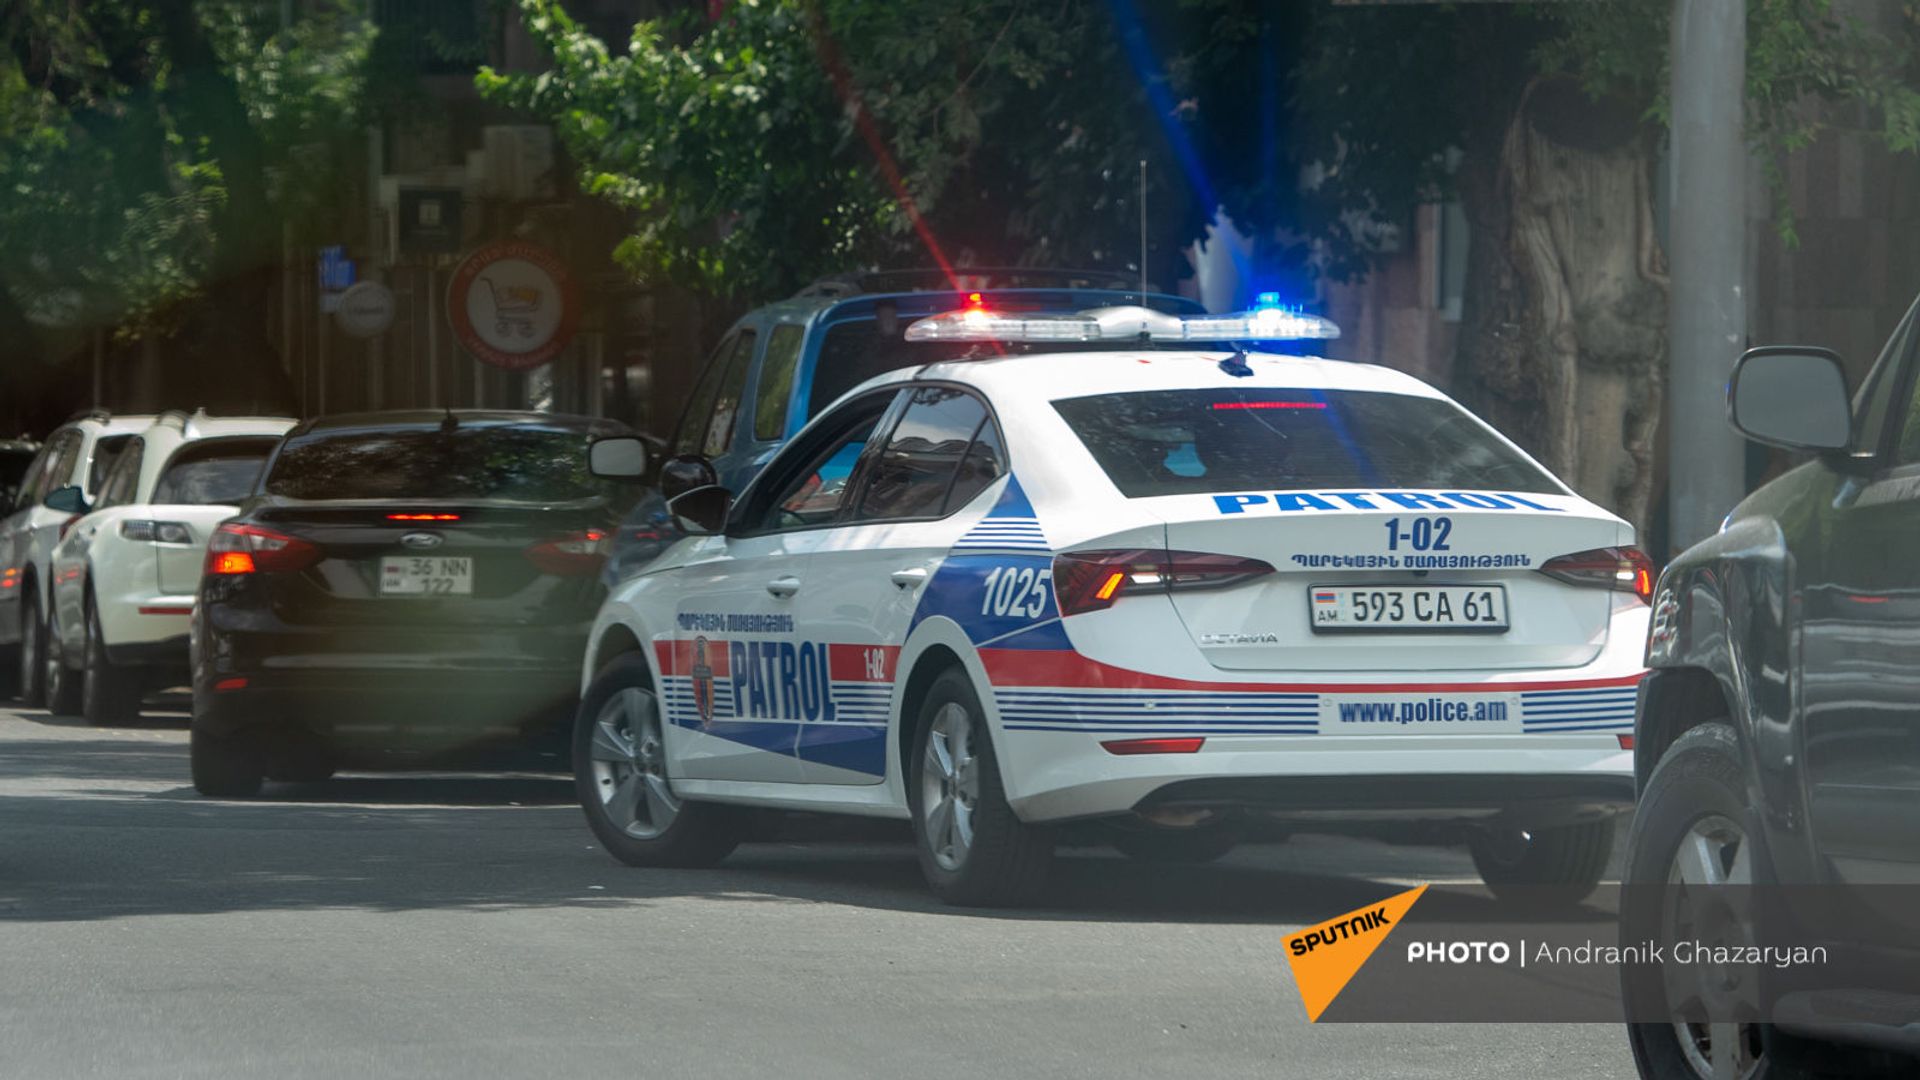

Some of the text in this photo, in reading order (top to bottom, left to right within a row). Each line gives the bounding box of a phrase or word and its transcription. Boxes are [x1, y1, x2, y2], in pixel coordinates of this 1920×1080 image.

[1212, 493, 1566, 515] PATROL
[1384, 517, 1452, 551] 1-02
[410, 558, 434, 576] 36
[981, 566, 1052, 618] 1025
[1352, 591, 1498, 623] 593 CA 61
[1317, 609, 1338, 623] AM
[863, 647, 886, 680] 1-02
[729, 640, 837, 722] PATROL
[1338, 698, 1508, 725] www.police.am
